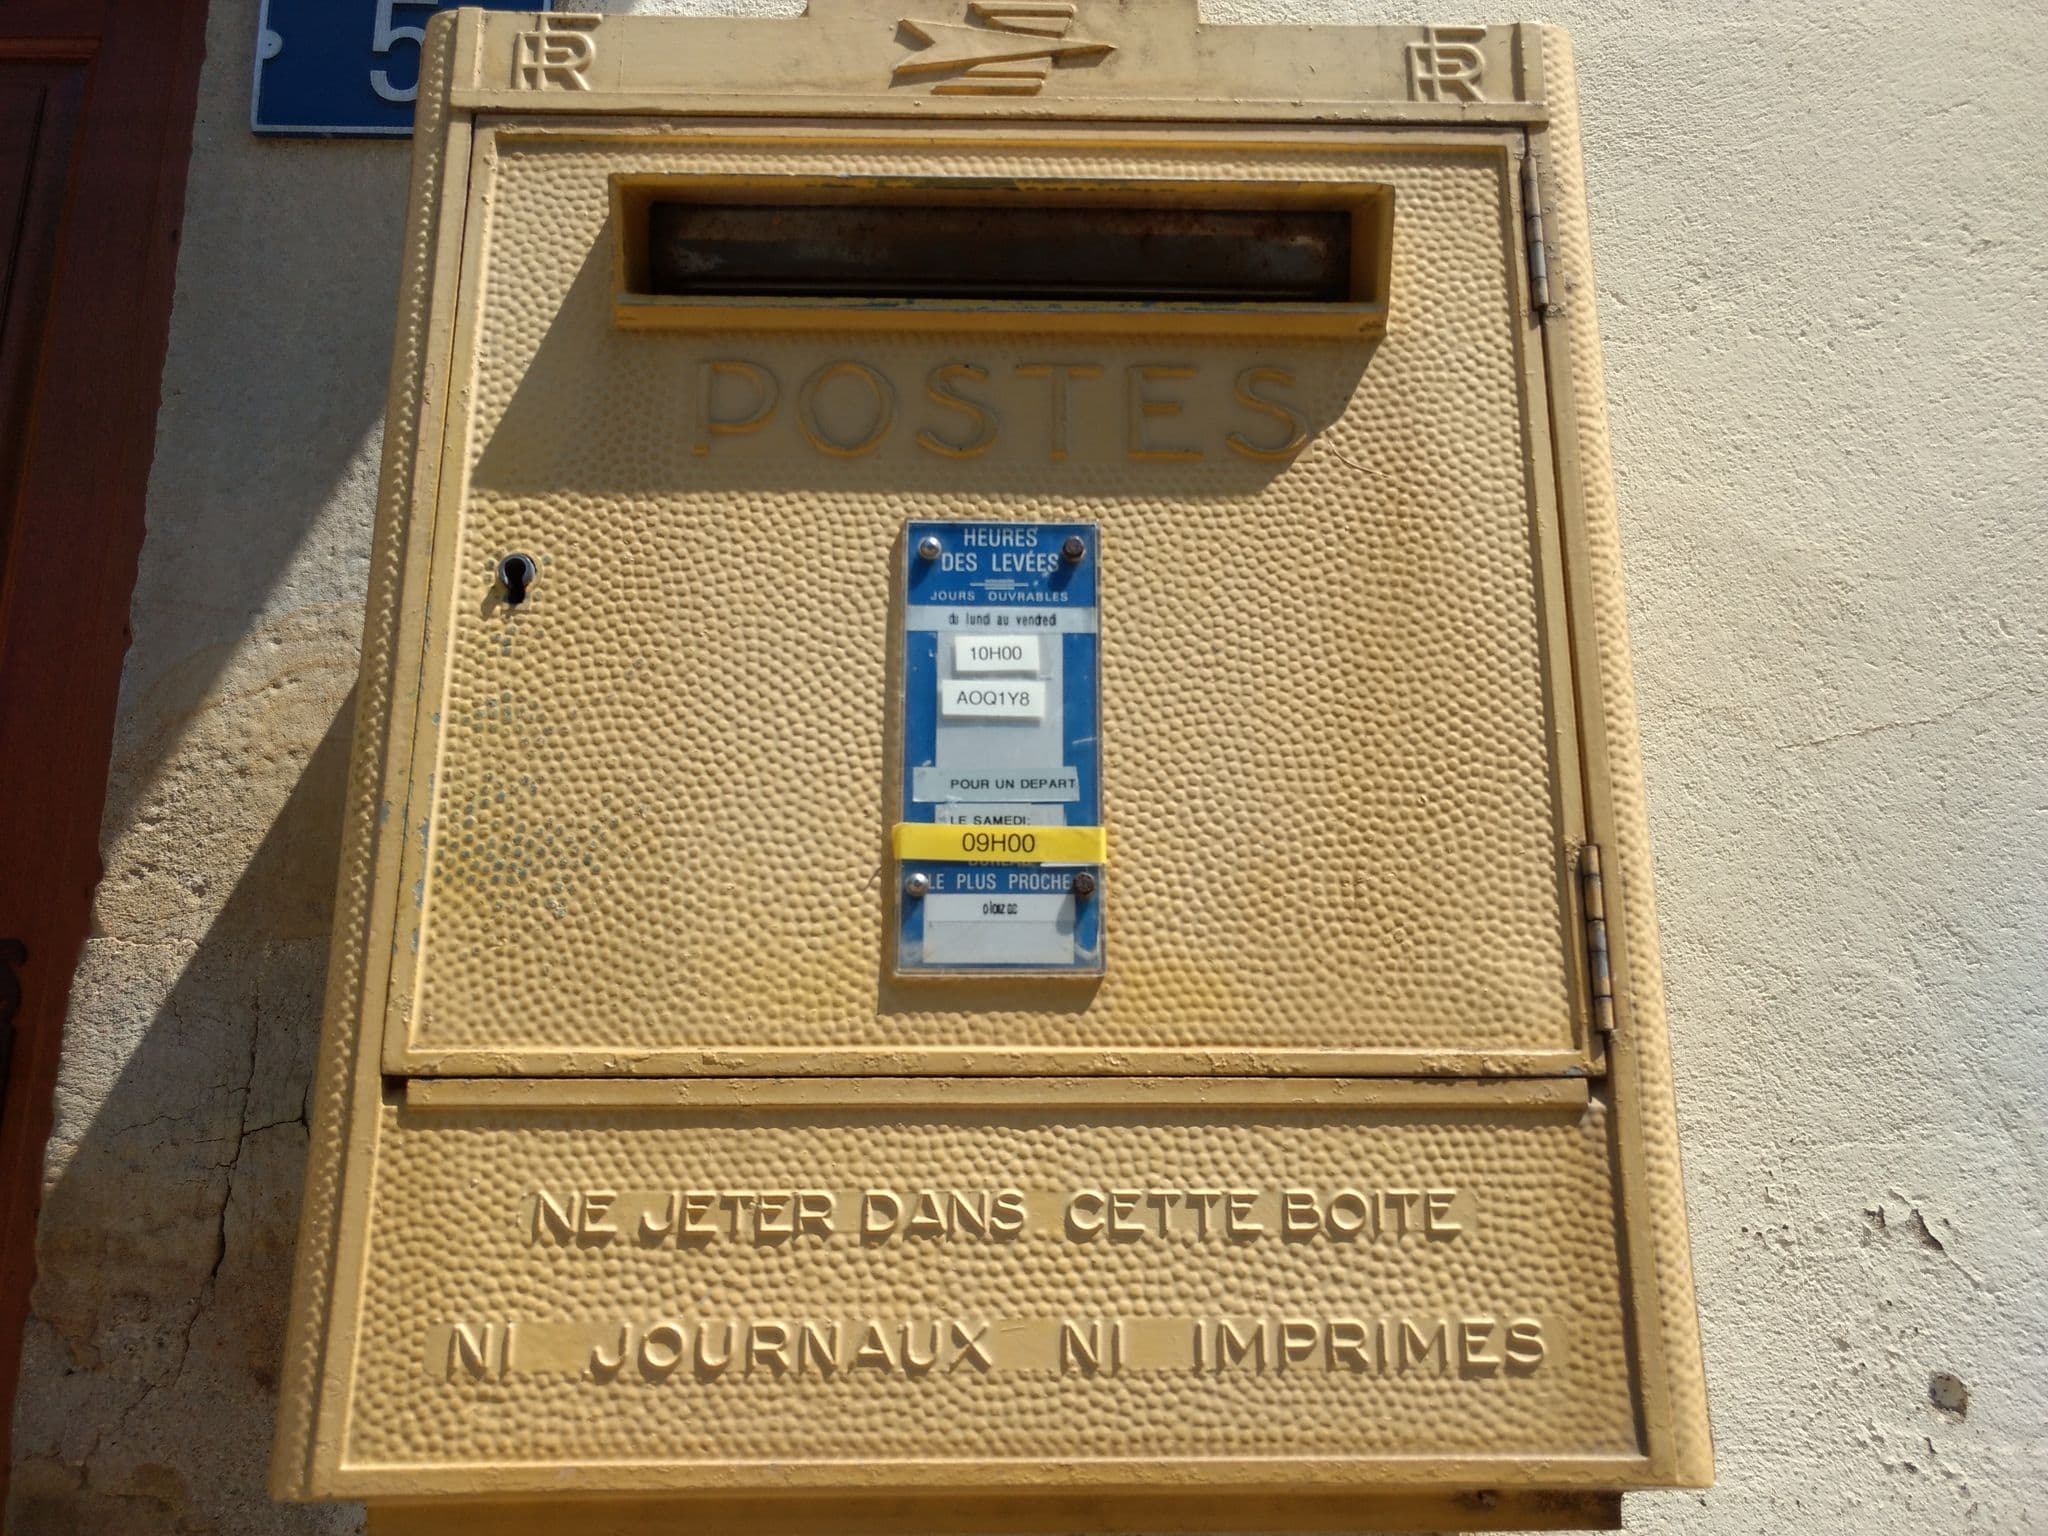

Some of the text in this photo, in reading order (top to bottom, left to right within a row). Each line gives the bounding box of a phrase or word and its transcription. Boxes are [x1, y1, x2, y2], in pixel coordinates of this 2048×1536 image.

[693, 358, 1312, 461] POSTES
[964, 527, 1038, 547] HEURES
[942, 551, 1059, 572] DES LEVÉES
[930, 591, 1069, 602] JOURS OUVRABLES
[997, 614, 1009, 625] au
[970, 646, 1023, 661] 10H00
[950, 778, 1076, 790] POUR UN DEPART
[950, 815, 969, 825] LE
[962, 832, 1036, 853] 09H00
[927, 873, 1071, 890] LE PLUS PROCHE
[534, 1188, 1463, 1236] NE JETER DANS CETTE BOITE
[447, 1318, 1546, 1378] NI JOURNAUX NI IMPRIMES
